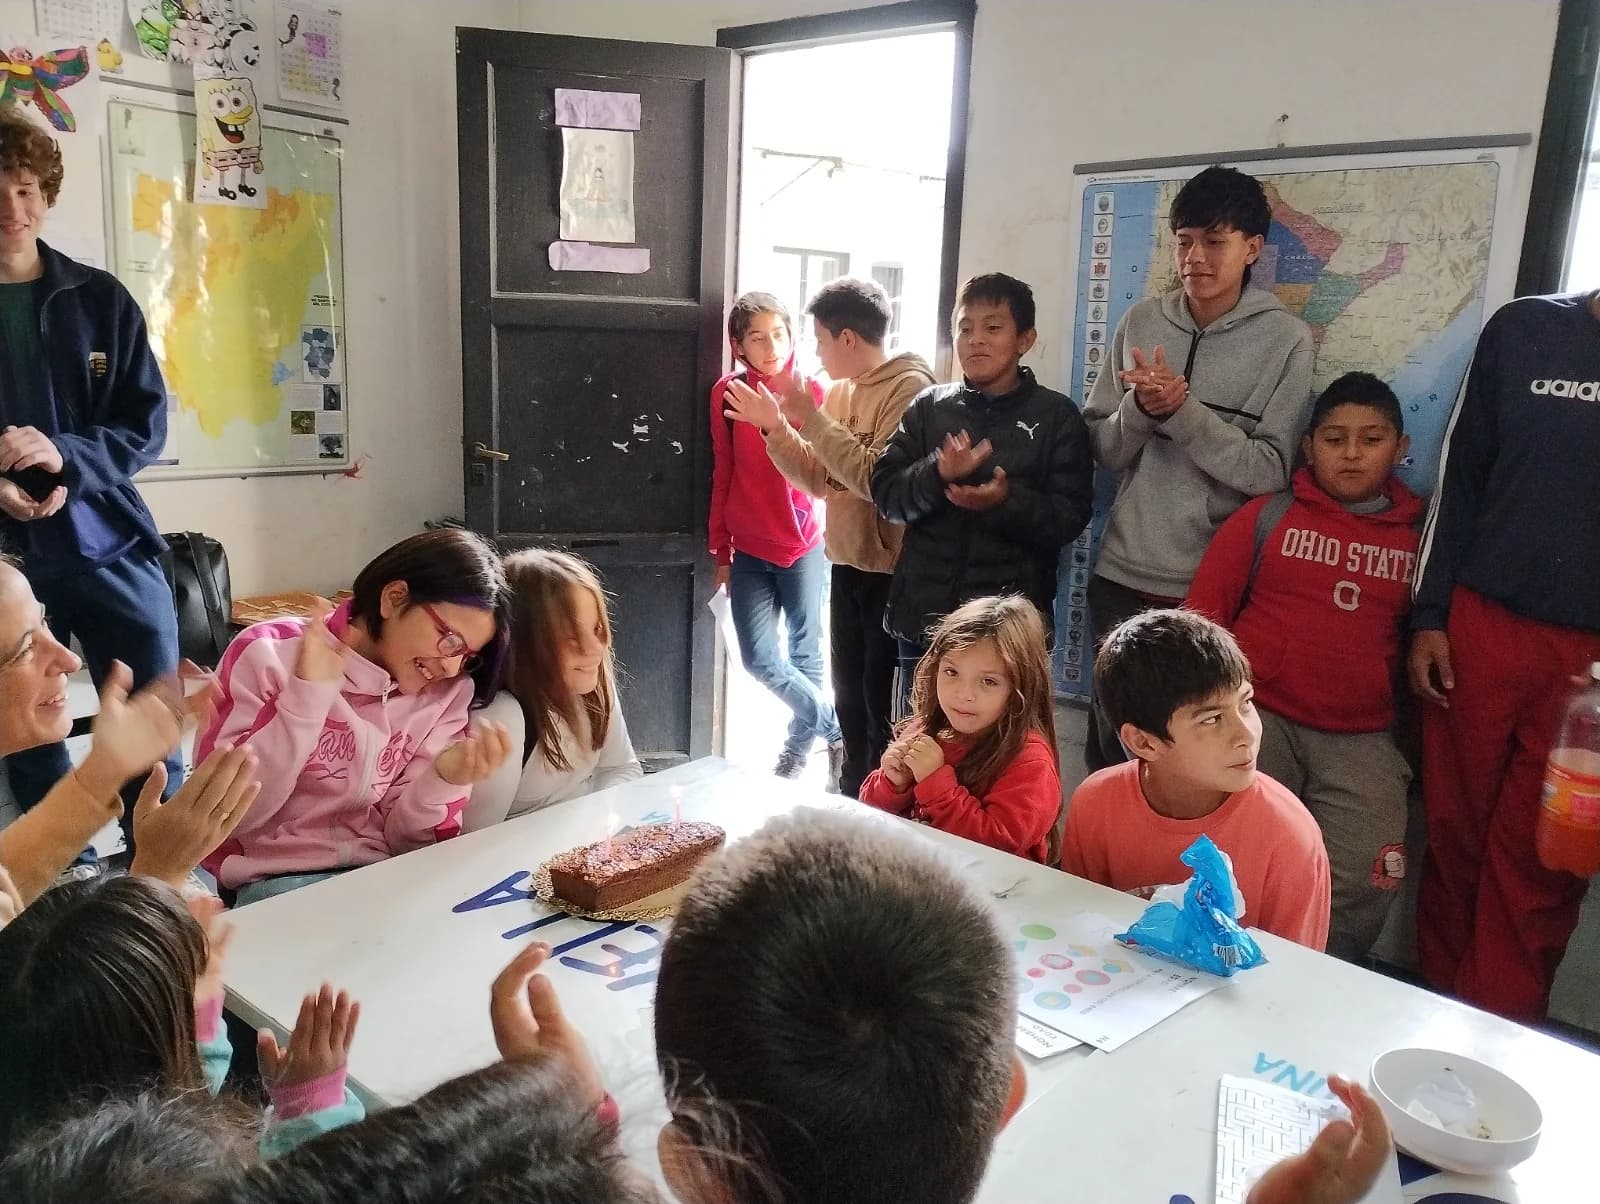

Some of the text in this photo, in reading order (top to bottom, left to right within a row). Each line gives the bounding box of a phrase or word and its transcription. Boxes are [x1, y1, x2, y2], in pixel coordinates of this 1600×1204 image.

[1281, 528, 1416, 583] OHIO STATE
[1333, 580, 1361, 612] O
